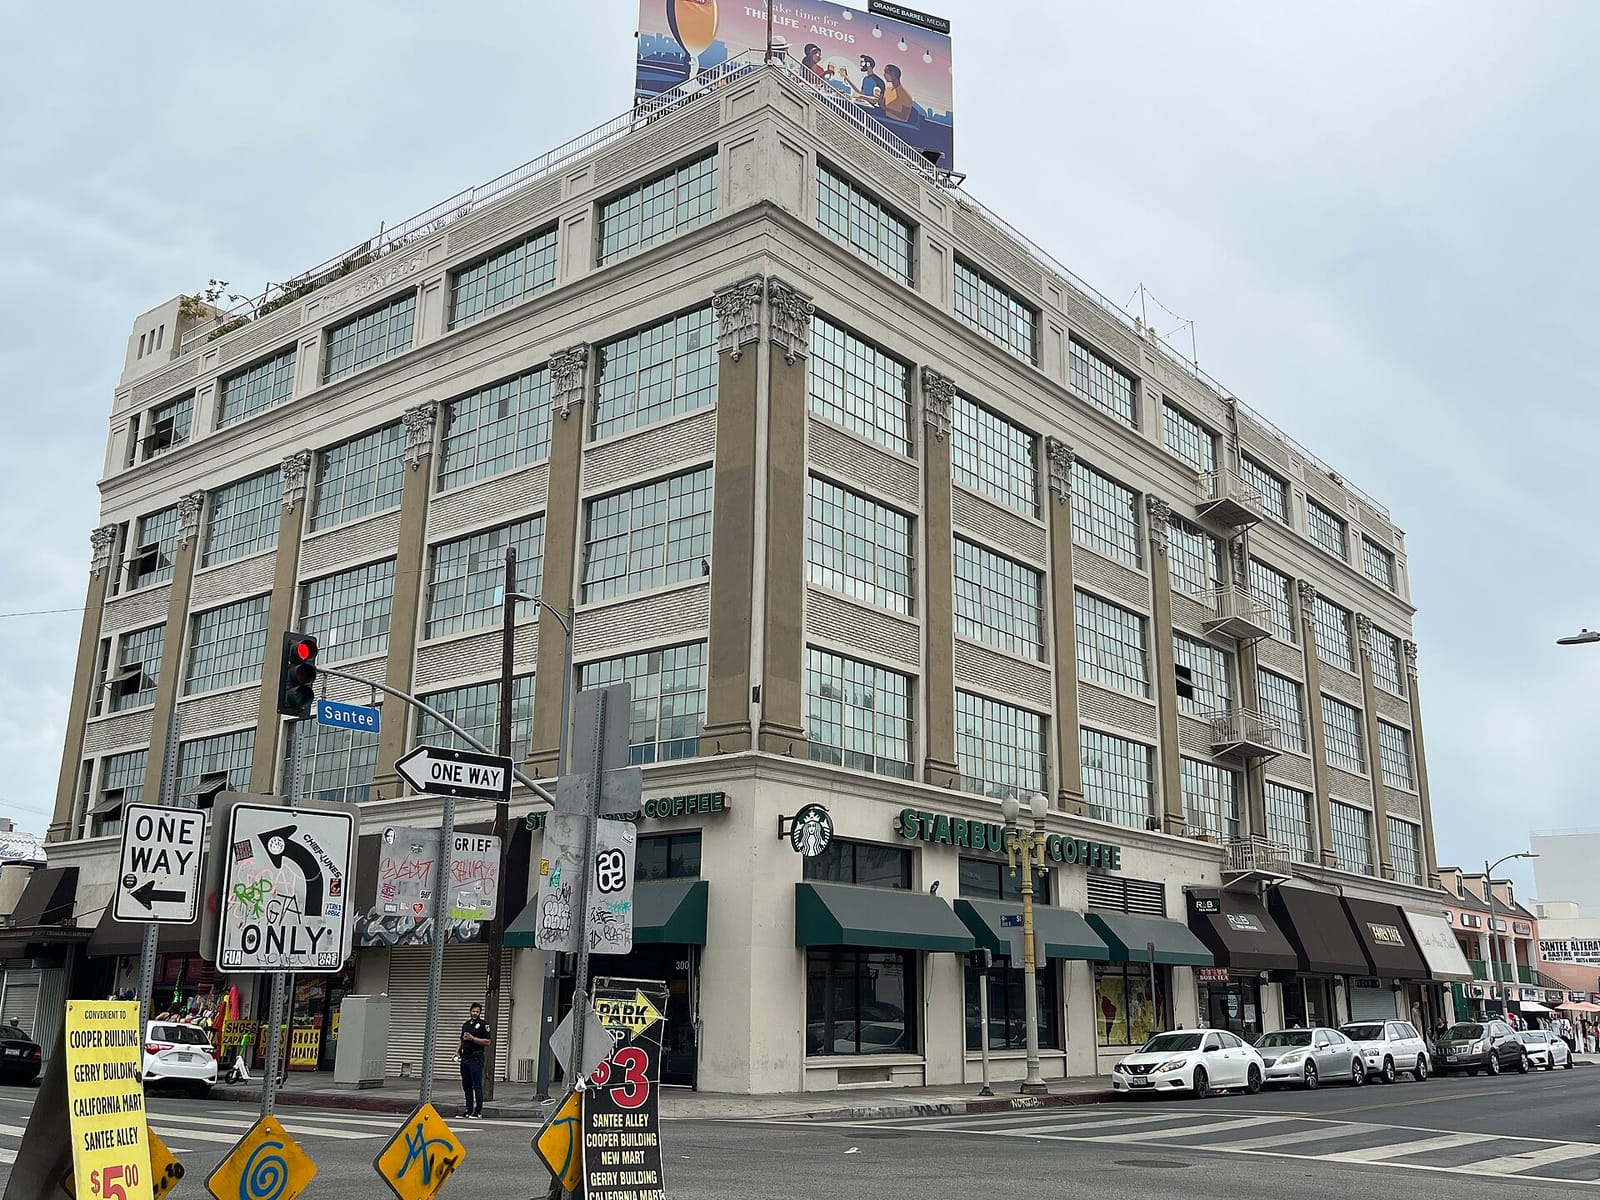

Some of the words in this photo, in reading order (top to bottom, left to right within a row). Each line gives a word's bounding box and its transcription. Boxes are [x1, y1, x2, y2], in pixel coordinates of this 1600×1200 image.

[795, 8, 820, 21] time
[823, 15, 839, 27] for
[873, 1, 900, 15] ORANGE
[901, 9, 924, 22] BARREL
[926, 18, 947, 29] MEDIA
[744, 6, 768, 21] THE
[773, 15, 799, 28] LIFE
[810, 25, 855, 44] ARTOIS
[325, 706, 373, 726] Santee
[431, 762, 463, 782] ONE
[468, 769, 500, 787] WAY
[644, 791, 723, 818] COFFEE
[135, 815, 195, 845] ONE
[900, 808, 1040, 858] STARBU
[1047, 833, 1121, 871] COFFEE
[455, 838, 492, 852] GRIEF
[131, 846, 194, 876] WAY
[303, 834, 323, 858] CHIEF
[319, 854, 342, 879] JUNES
[241, 924, 327, 955] ONLY
[1540, 941, 1568, 951] SANTEE
[224, 950, 241, 965] FUA
[676, 961, 689, 970] 300
[85, 1010, 118, 1020] CONVENIENT
[119, 1010, 126, 1019] TO
[599, 1003, 649, 1025] PARK
[70, 1031, 102, 1049] COOPER
[104, 1030, 138, 1047] BUILDING
[293, 1032, 319, 1044] SHOES
[291, 1047, 318, 1058] ZAPATOS
[74, 1063, 101, 1083] GERRY
[103, 1062, 138, 1081] BUILDING
[74, 1095, 121, 1118] CALIFORNIA
[122, 1093, 142, 1112] MART
[592, 1113, 623, 1128] SANTEE
[625, 1113, 649, 1127] ALLEY
[84, 1129, 116, 1151] SANTEE
[116, 1127, 138, 1146] ALLEY
[586, 1133, 619, 1148] COOPER
[620, 1132, 657, 1147] BUILDING
[601, 1151, 619, 1165] NEW
[621, 1150, 645, 1164] MART
[590, 1171, 618, 1187] GERRY
[620, 1170, 658, 1185] BUILDING
[589, 1190, 638, 1200] CALIFORNIA
